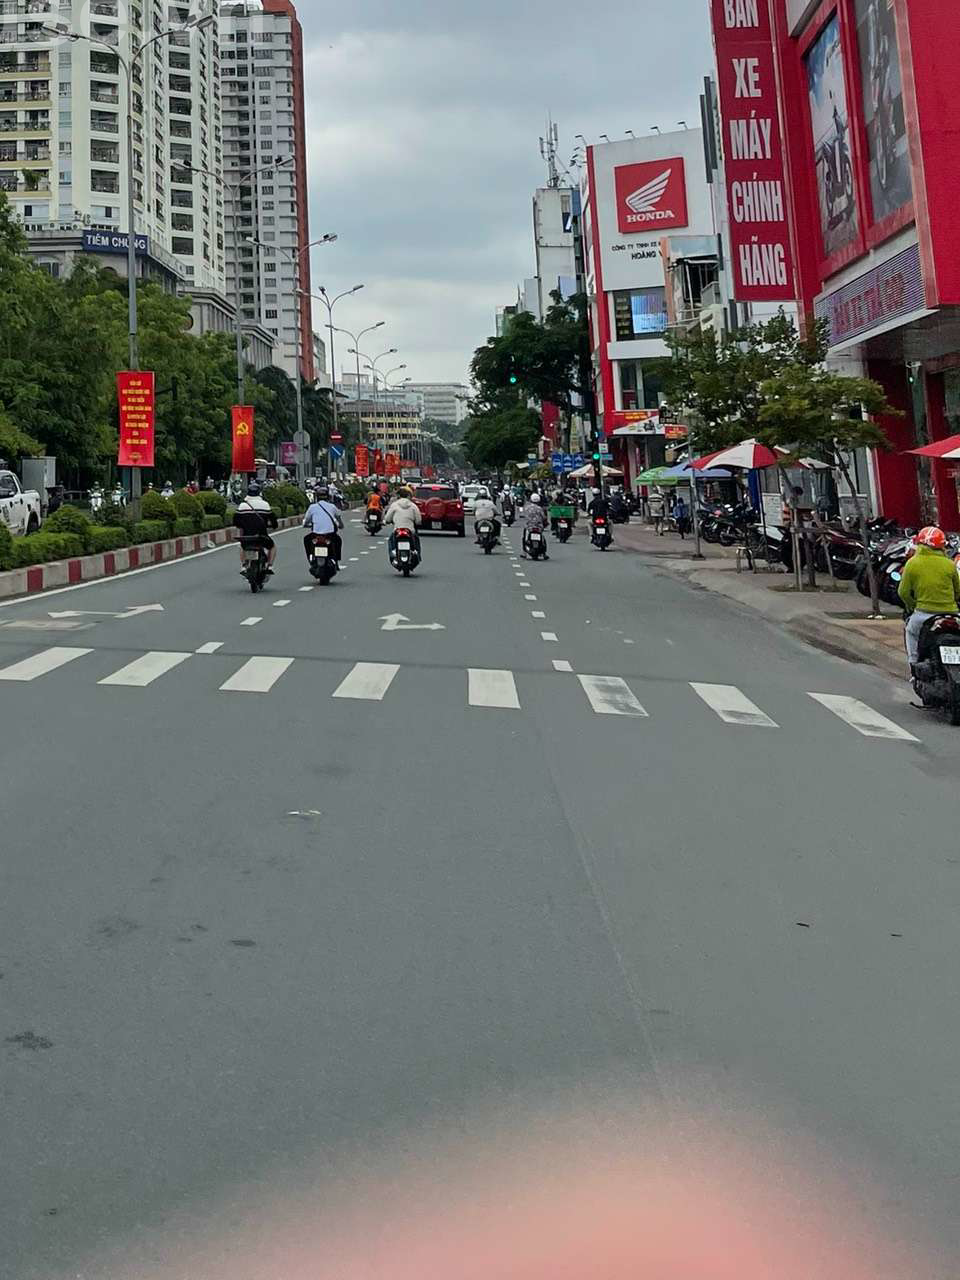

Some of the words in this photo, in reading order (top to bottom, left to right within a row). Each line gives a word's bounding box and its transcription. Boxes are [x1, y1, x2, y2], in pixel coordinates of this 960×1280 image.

[731, 57, 763, 99] XE
[729, 109, 772, 161] MÁY
[627, 210, 675, 222] HONDA
[731, 172, 785, 223] CHÍNH
[739, 235, 787, 287] HÃNG
